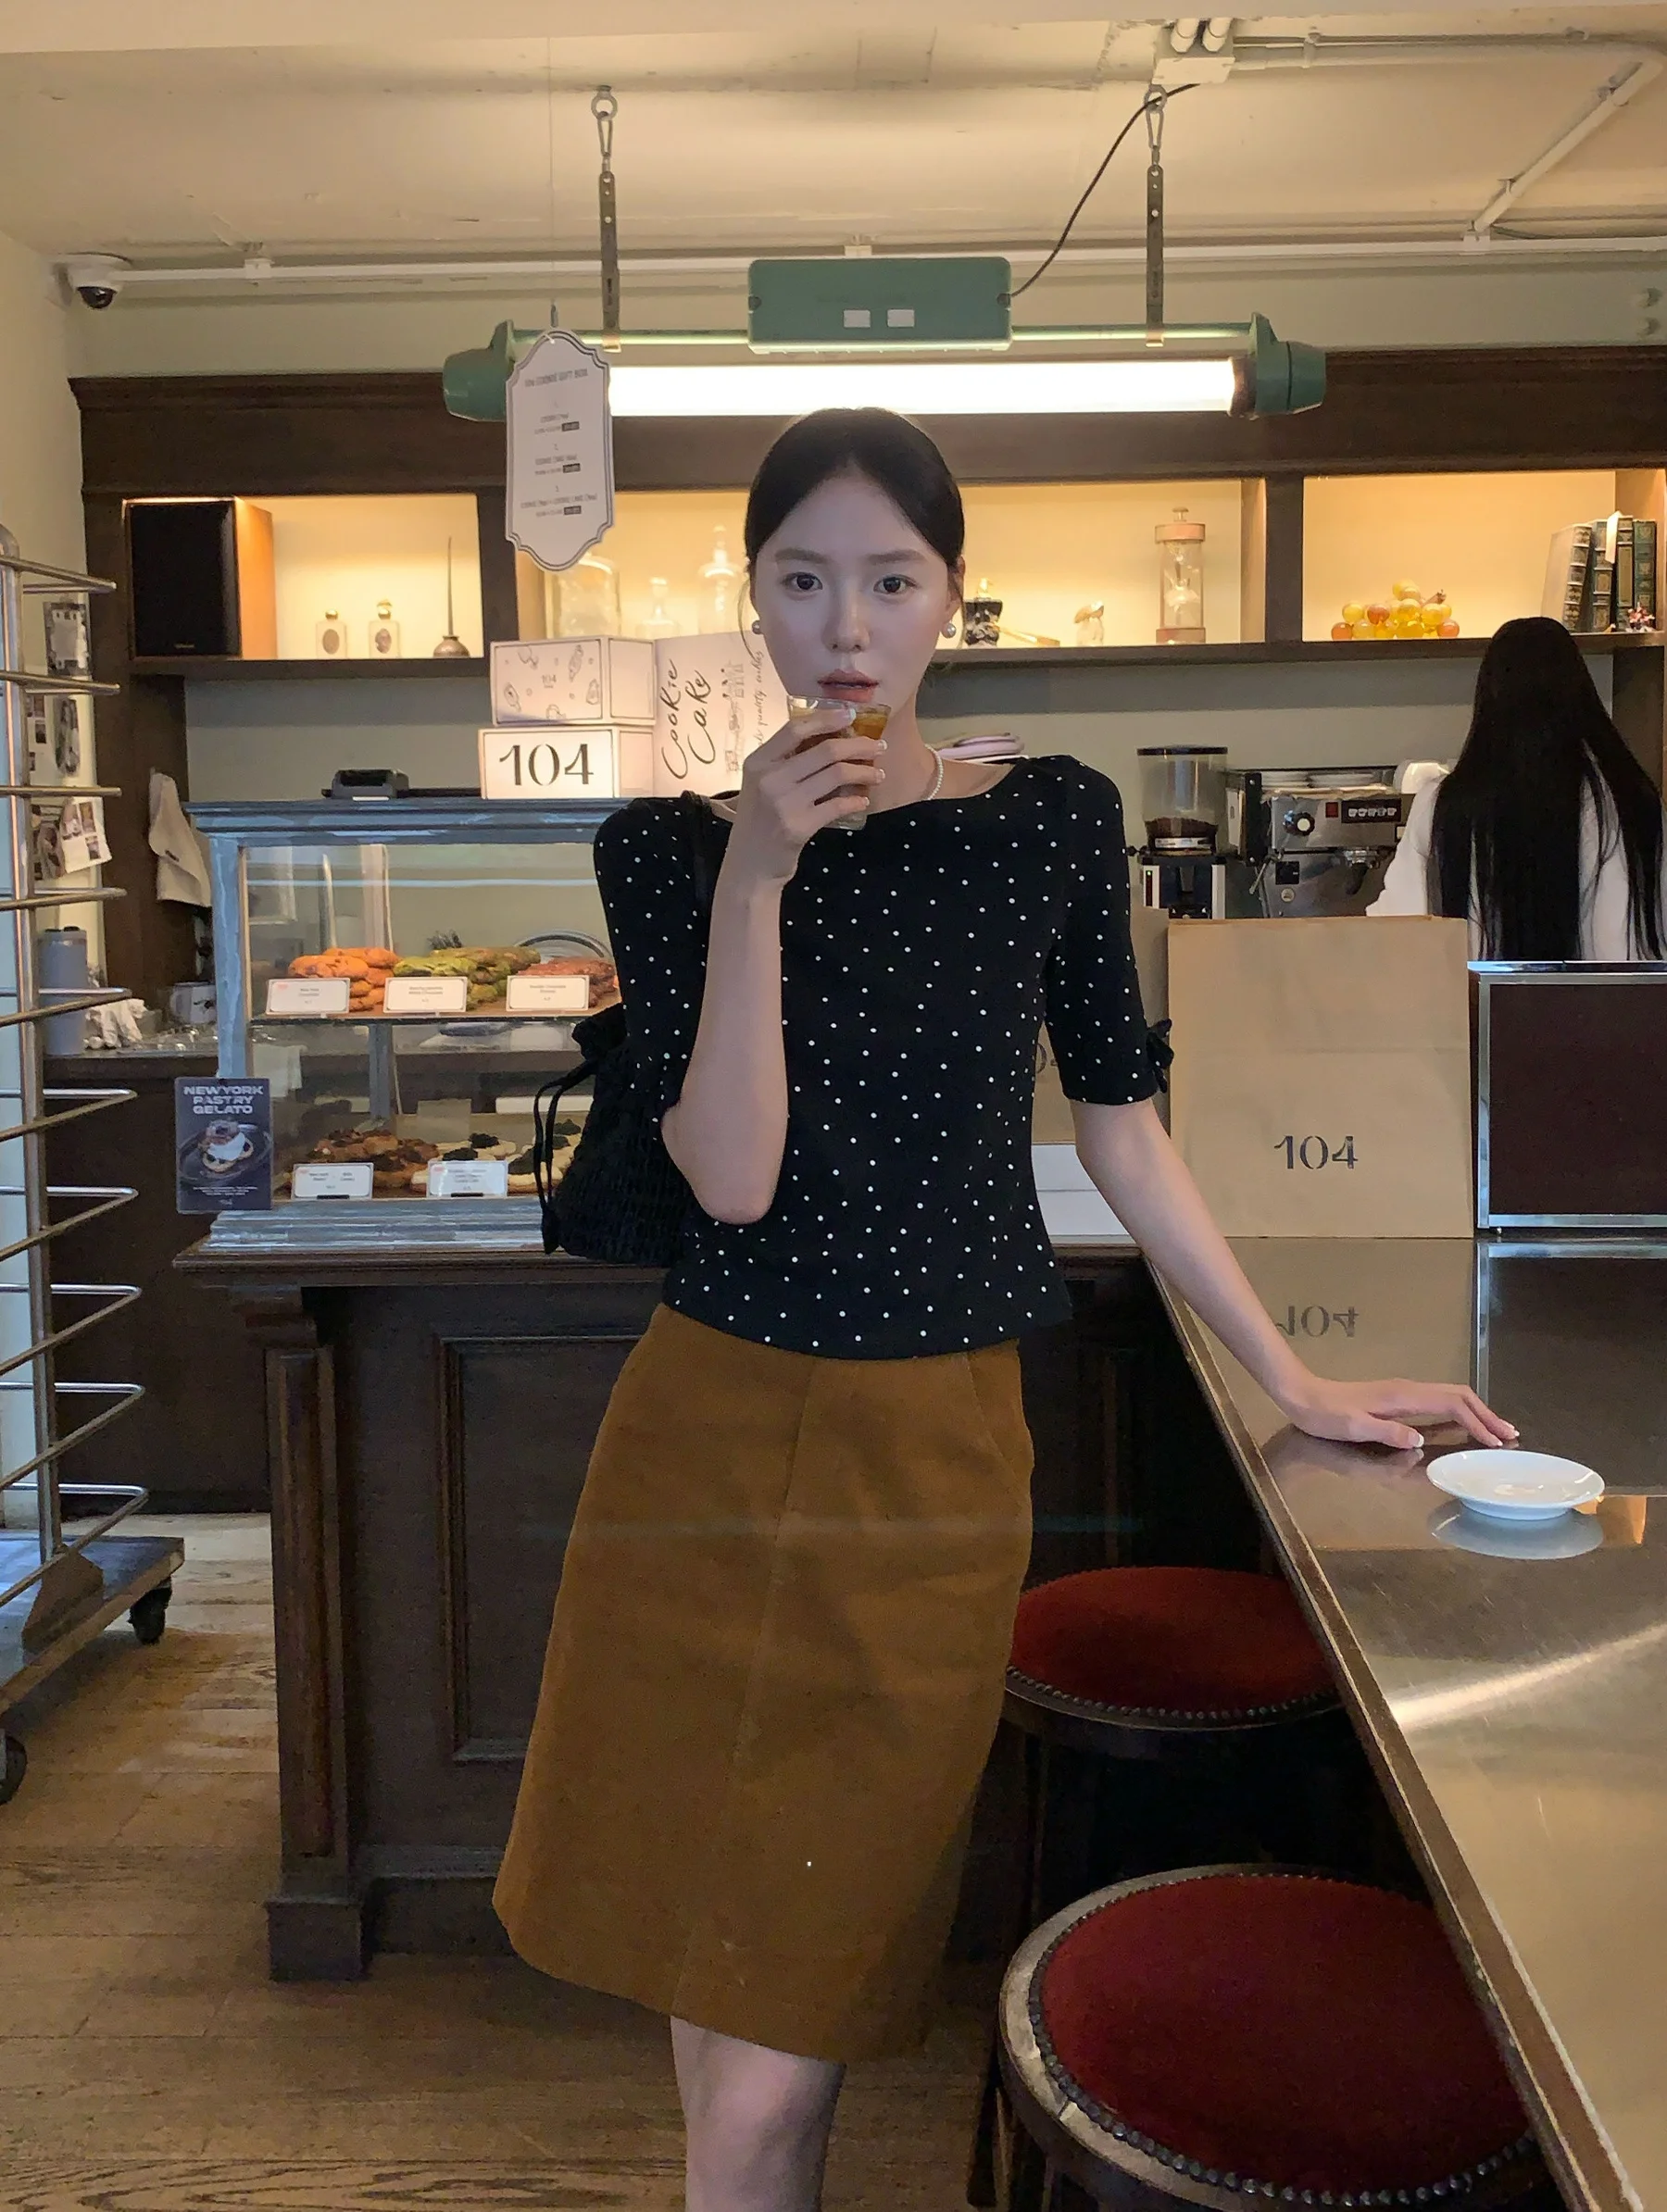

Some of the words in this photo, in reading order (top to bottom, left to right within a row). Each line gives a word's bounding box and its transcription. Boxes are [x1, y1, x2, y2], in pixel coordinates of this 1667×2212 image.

[659, 658, 689, 780] Cookie
[684, 669, 717, 765] Cake
[498, 743, 595, 786] 104
[193, 1095, 254, 1105] PASTRY
[193, 1105, 254, 1115] GELATO
[1273, 1135, 1359, 1169] 104
